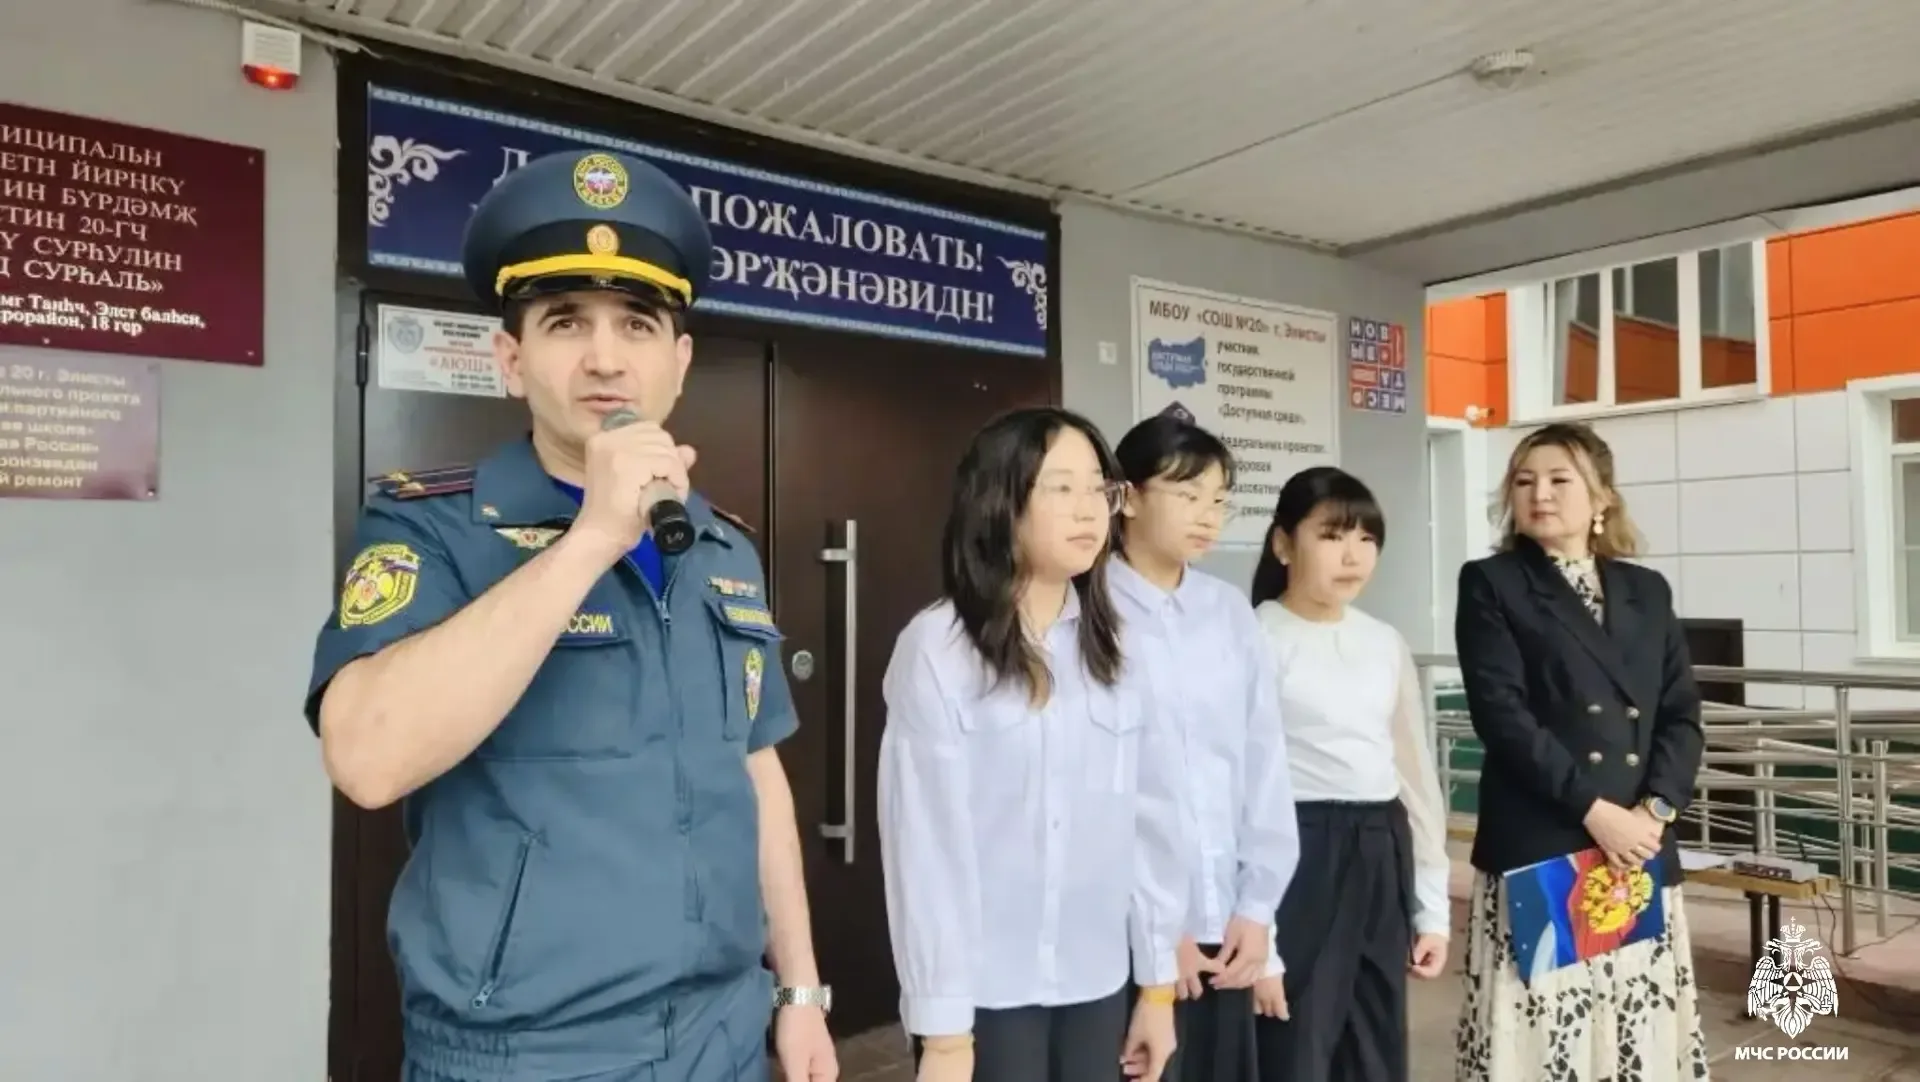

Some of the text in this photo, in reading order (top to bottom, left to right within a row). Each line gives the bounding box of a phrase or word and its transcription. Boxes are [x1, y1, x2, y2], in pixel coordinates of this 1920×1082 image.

[0, 125, 162, 168] ИЦИПАЛЬН
[0, 151, 56, 177] ЕТН
[0, 178, 46, 201] ИН
[0, 205, 66, 231] ТИН
[689, 185, 984, 272] ПОЖАЛОВАТЬ!
[0, 310, 85, 331] рорайон,
[91, 315, 110, 330] 18
[1149, 300, 1190, 321] МБОУ
[0, 384, 64, 400] льного
[14, 474, 84, 488] ремонт
